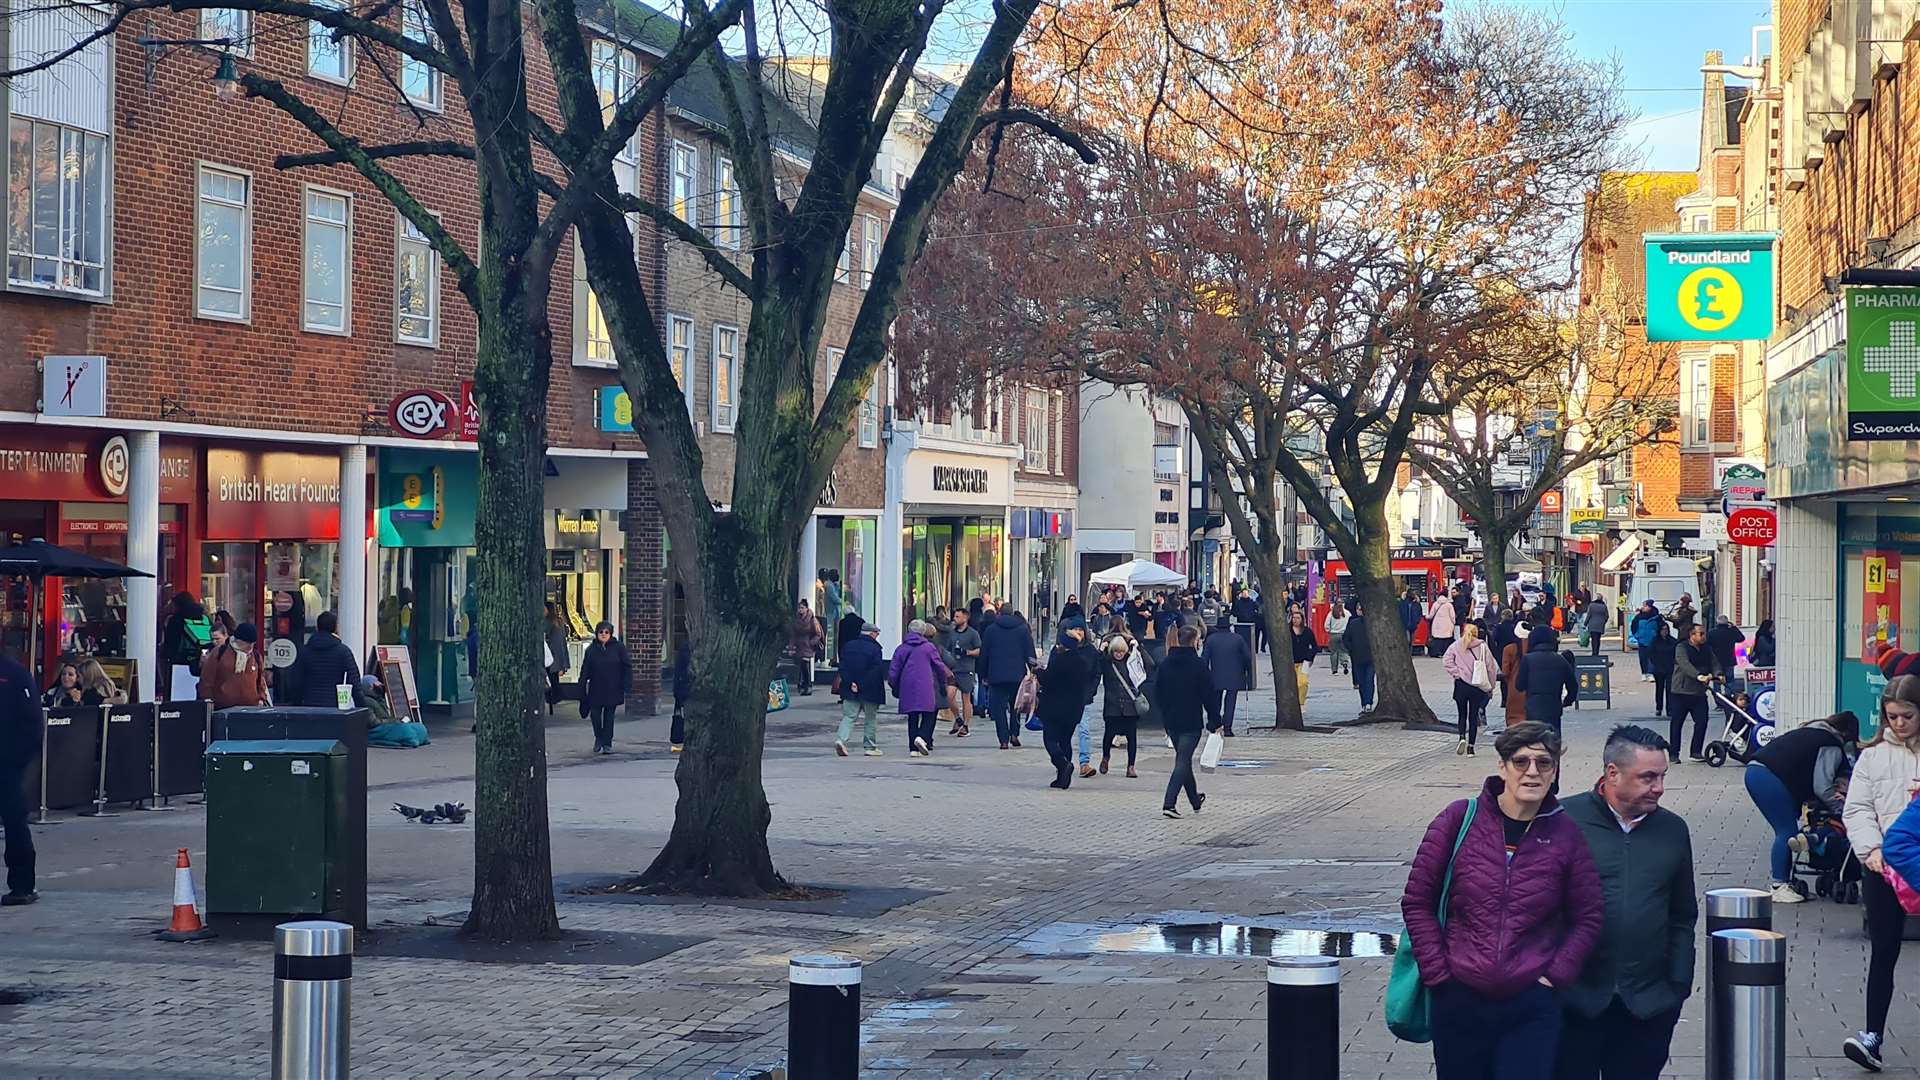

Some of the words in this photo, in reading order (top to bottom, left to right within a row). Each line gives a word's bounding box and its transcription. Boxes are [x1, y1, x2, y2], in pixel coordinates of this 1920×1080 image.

[1668, 250, 1751, 264] Poundland
[220, 475, 260, 502] British
[263, 478, 297, 502] Heart
[1574, 510, 1585, 518] TO
[557, 514, 580, 533] Warren
[580, 514, 598, 533] James
[1740, 517, 1769, 527] POST
[1732, 527, 1773, 537] OFFICE
[554, 559, 571, 567] SALE
[1869, 564, 1882, 583] £1
[1747, 670, 1768, 680] Half
